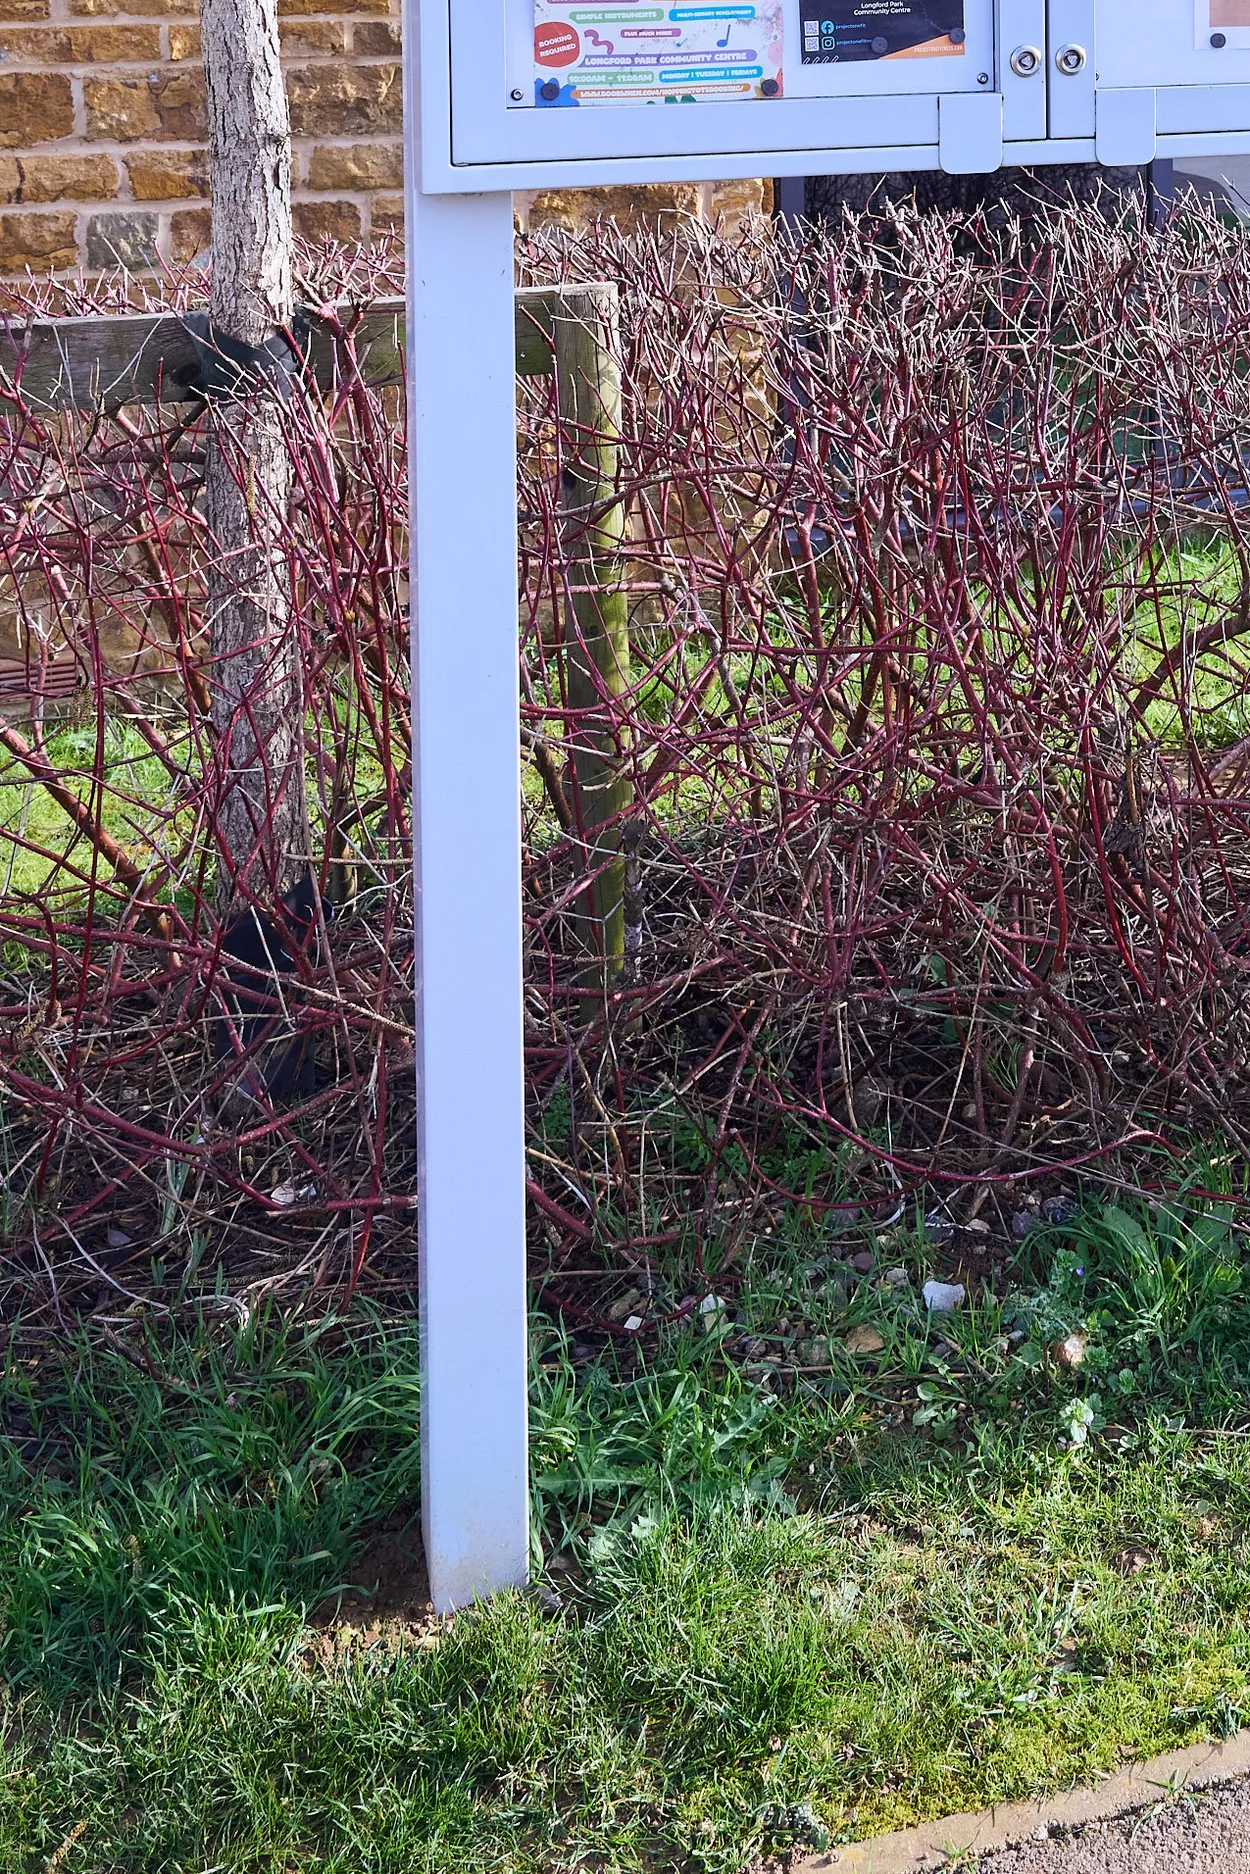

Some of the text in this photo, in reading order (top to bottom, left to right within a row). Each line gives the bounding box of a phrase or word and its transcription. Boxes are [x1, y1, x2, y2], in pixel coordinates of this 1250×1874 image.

[861, 1, 888, 9] Longford
[604, 11, 657, 19] INSTRUMENTS
[853, 8, 890, 16] Community
[538, 34, 573, 48] BOOKING
[539, 43, 577, 57] REQUIRED
[584, 52, 748, 66] LONGFORD PARK COMMUNITY CENTRE
[662, 72, 690, 80] MONDAY
